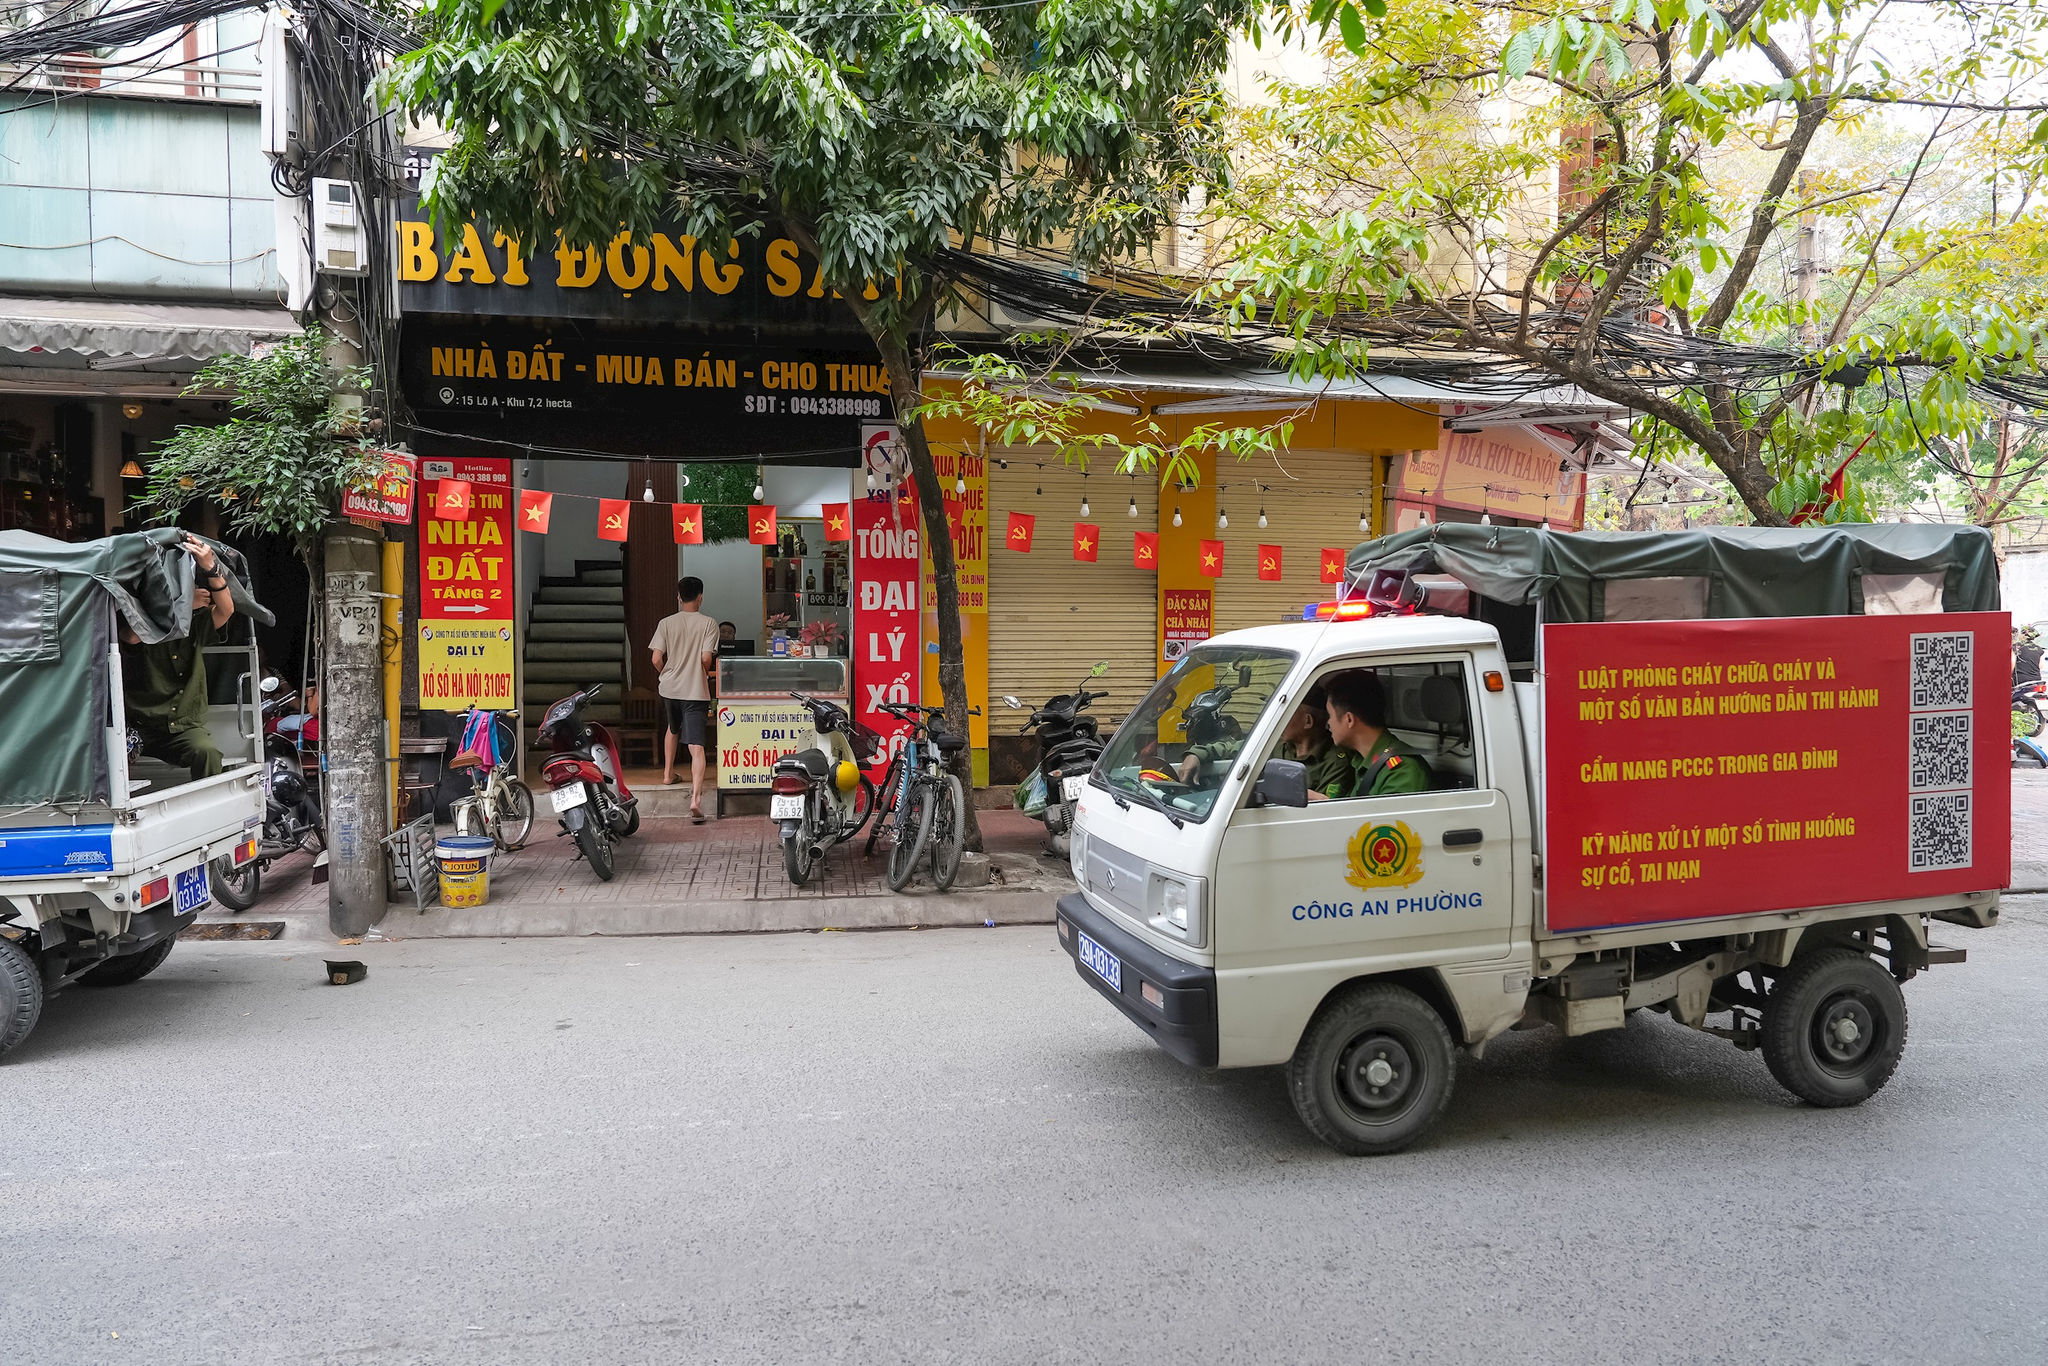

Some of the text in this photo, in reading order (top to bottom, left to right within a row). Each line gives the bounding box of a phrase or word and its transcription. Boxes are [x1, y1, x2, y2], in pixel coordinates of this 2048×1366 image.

[431, 341, 498, 379] NHÀ
[506, 338, 565, 382] ĐẤT
[596, 354, 665, 386] MUA
[674, 350, 736, 388] BÁN
[761, 360, 818, 391] CHO
[476, 396, 488, 406] Lô
[491, 398, 499, 407] A
[506, 397, 525, 408] Khu
[527, 398, 543, 409] 7,2
[545, 398, 573, 409] hecta
[744, 395, 777, 413] SĐT
[790, 396, 881, 417] 0943388998
[464, 464, 494, 472] Hotline
[1455, 434, 1558, 490] BIA HƠI HÀ NỘI
[479, 493, 503, 510] TIN
[427, 516, 504, 545] NHÀ
[856, 516, 918, 560] TỔNG
[426, 548, 504, 581] ĐẤT
[432, 584, 502, 600] TẦNG 2
[961, 574, 970, 585] BA
[860, 580, 916, 617] ĐẠI
[1166, 593, 1209, 614] ĐẶC SẢN
[435, 629, 446, 639] CÔNG
[446, 630, 450, 639] TY
[1165, 612, 1209, 629] CHẢ NHÁI
[446, 643, 486, 657] ĐẠI LÝ
[869, 626, 906, 662] LÝ
[422, 662, 511, 704] XỔ SỐ HÀ NỘI 31097
[1578, 656, 1836, 694] LUẬT PHÒNG CHÁY CHỮA CHÁY VÀ
[866, 671, 912, 714] XỔ
[1579, 685, 1879, 726] MỘT SỐ VĂN BẢN HƯỚNG DẪN THI HÀNH
[740, 711, 754, 723] CÔNG
[754, 713, 761, 723] TY
[761, 710, 768, 723] XỔ
[769, 711, 777, 723] SỐ
[777, 711, 789, 723] KIẾN
[789, 711, 803, 723] THIẾT
[761, 729, 785, 742] ĐẠI
[722, 742, 740, 768] XỔ
[743, 743, 760, 768] SỐ
[762, 745, 779, 768] HÀ
[1580, 747, 1839, 784] CẨM NANG PCCC TRONG GIA ĐÌNH
[729, 774, 740, 784] LH:
[741, 772, 757, 784] ÔNG
[1581, 812, 1856, 856] KỸ NĂNG XỬ LÝ MỘT SỐ TÌNH HUỐNG
[183, 866, 200, 887] 29A
[450, 863, 478, 871] JOTUN
[1581, 858, 1701, 890] SỰ CỐ, TAI NẠN
[178, 882, 208, 910] 031.34
[1291, 890, 1483, 921] CÔNG AN PHƯỜNG
